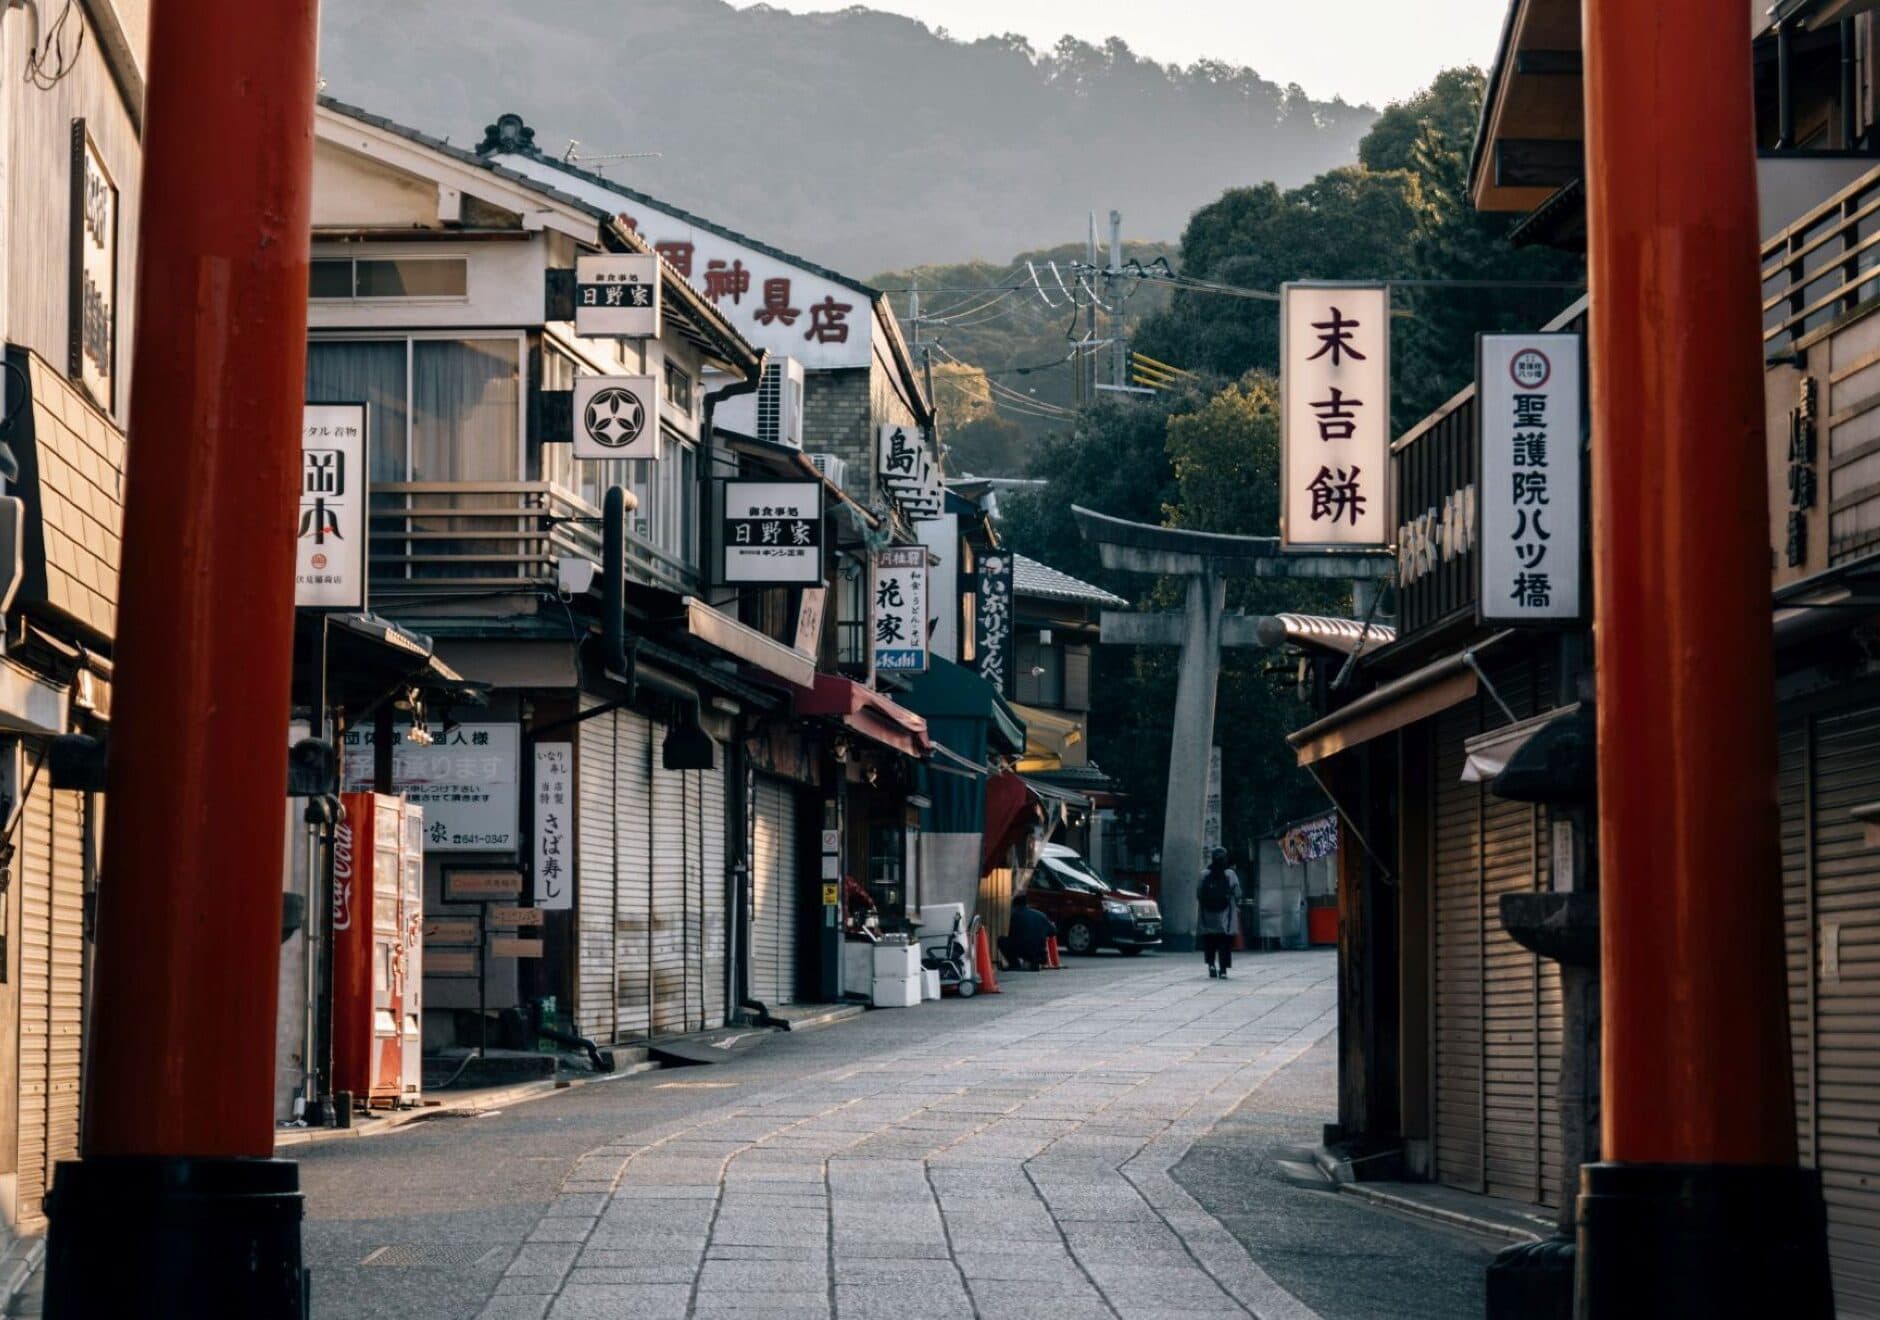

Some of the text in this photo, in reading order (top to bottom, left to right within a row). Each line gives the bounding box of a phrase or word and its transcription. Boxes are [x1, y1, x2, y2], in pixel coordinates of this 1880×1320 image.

[583, 285, 649, 306] 日野家
[1306, 306, 1367, 526] 末吉餅
[735, 520, 811, 545] 日野家
[1510, 393, 1553, 608] 聖護院八ツ橋
[876, 578, 905, 645] 花家
[876, 652, 916, 669] Asahi
[541, 813, 563, 898] さば寿し
